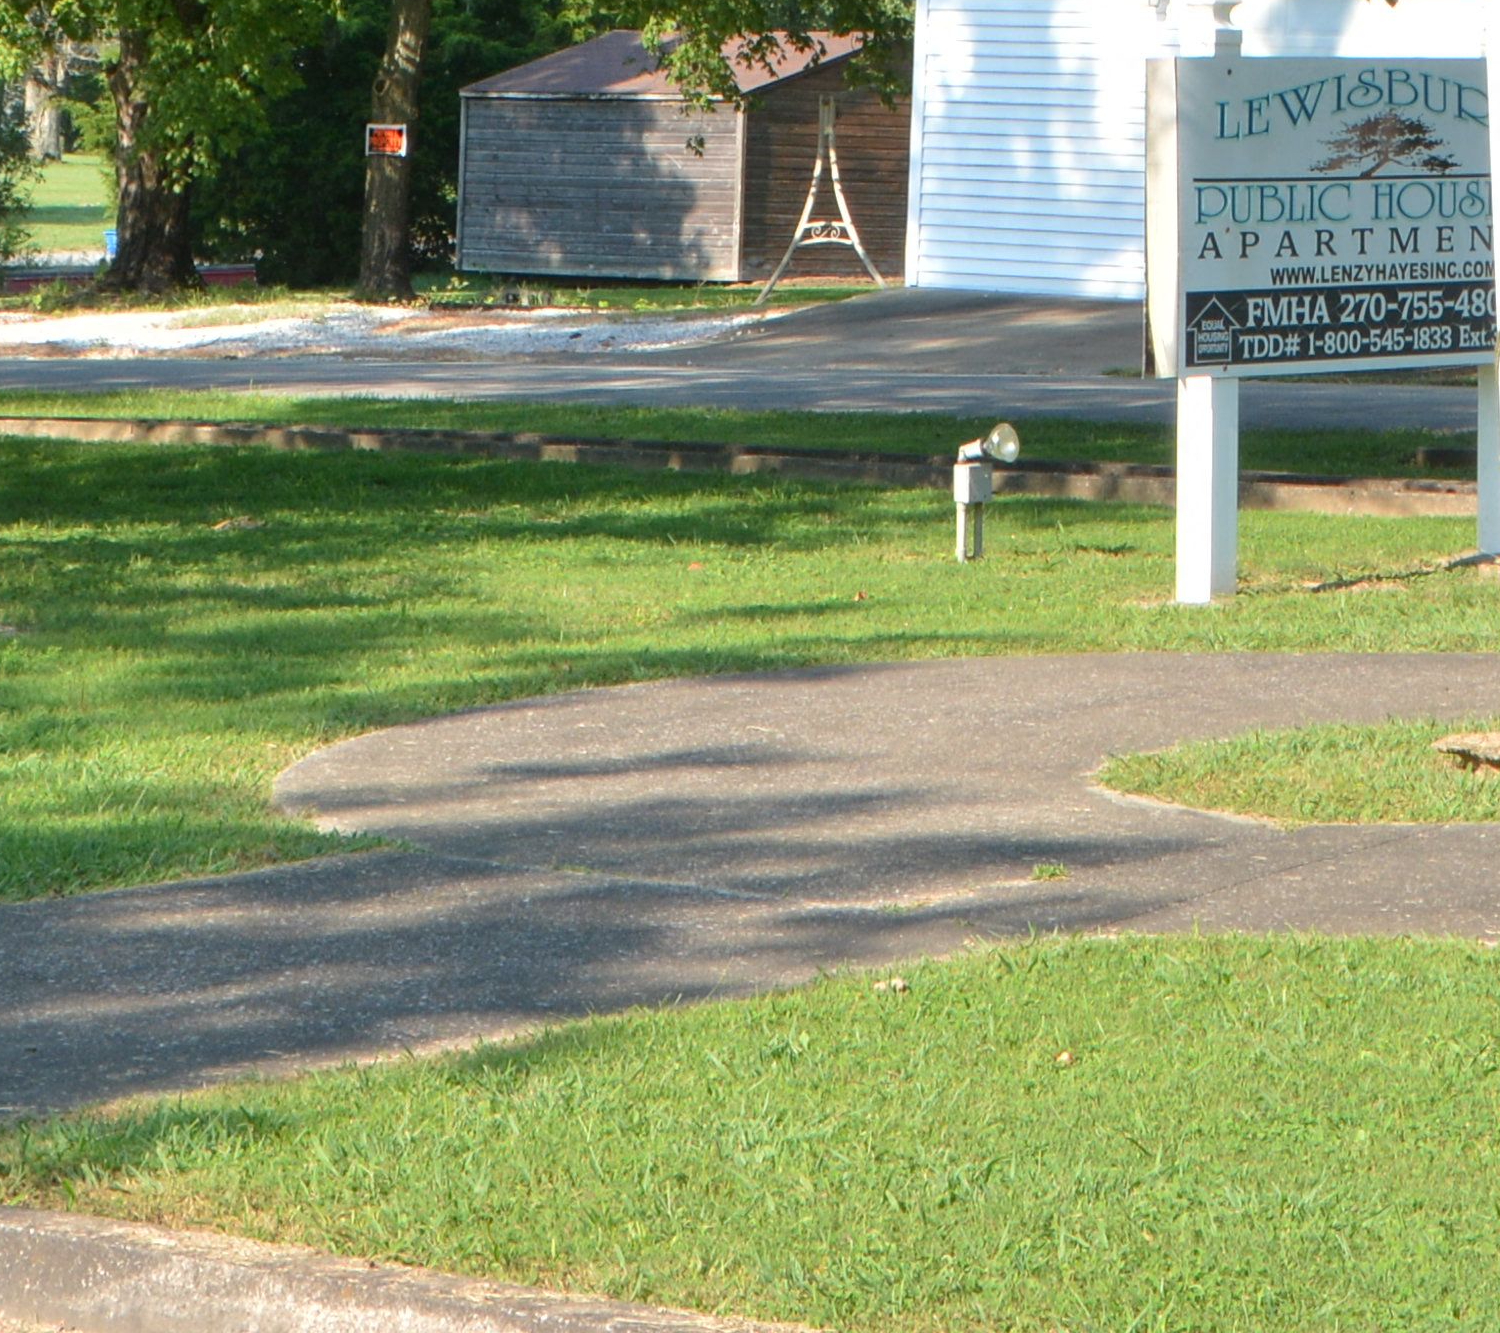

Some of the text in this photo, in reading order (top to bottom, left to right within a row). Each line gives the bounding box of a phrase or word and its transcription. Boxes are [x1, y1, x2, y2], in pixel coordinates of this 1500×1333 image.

[1194, 183, 1351, 225] PUBLIC
[1246, 294, 1331, 329] FMHA
[1239, 333, 1300, 359] TDD#
[1307, 325, 1452, 356] 1-800-545-1833
